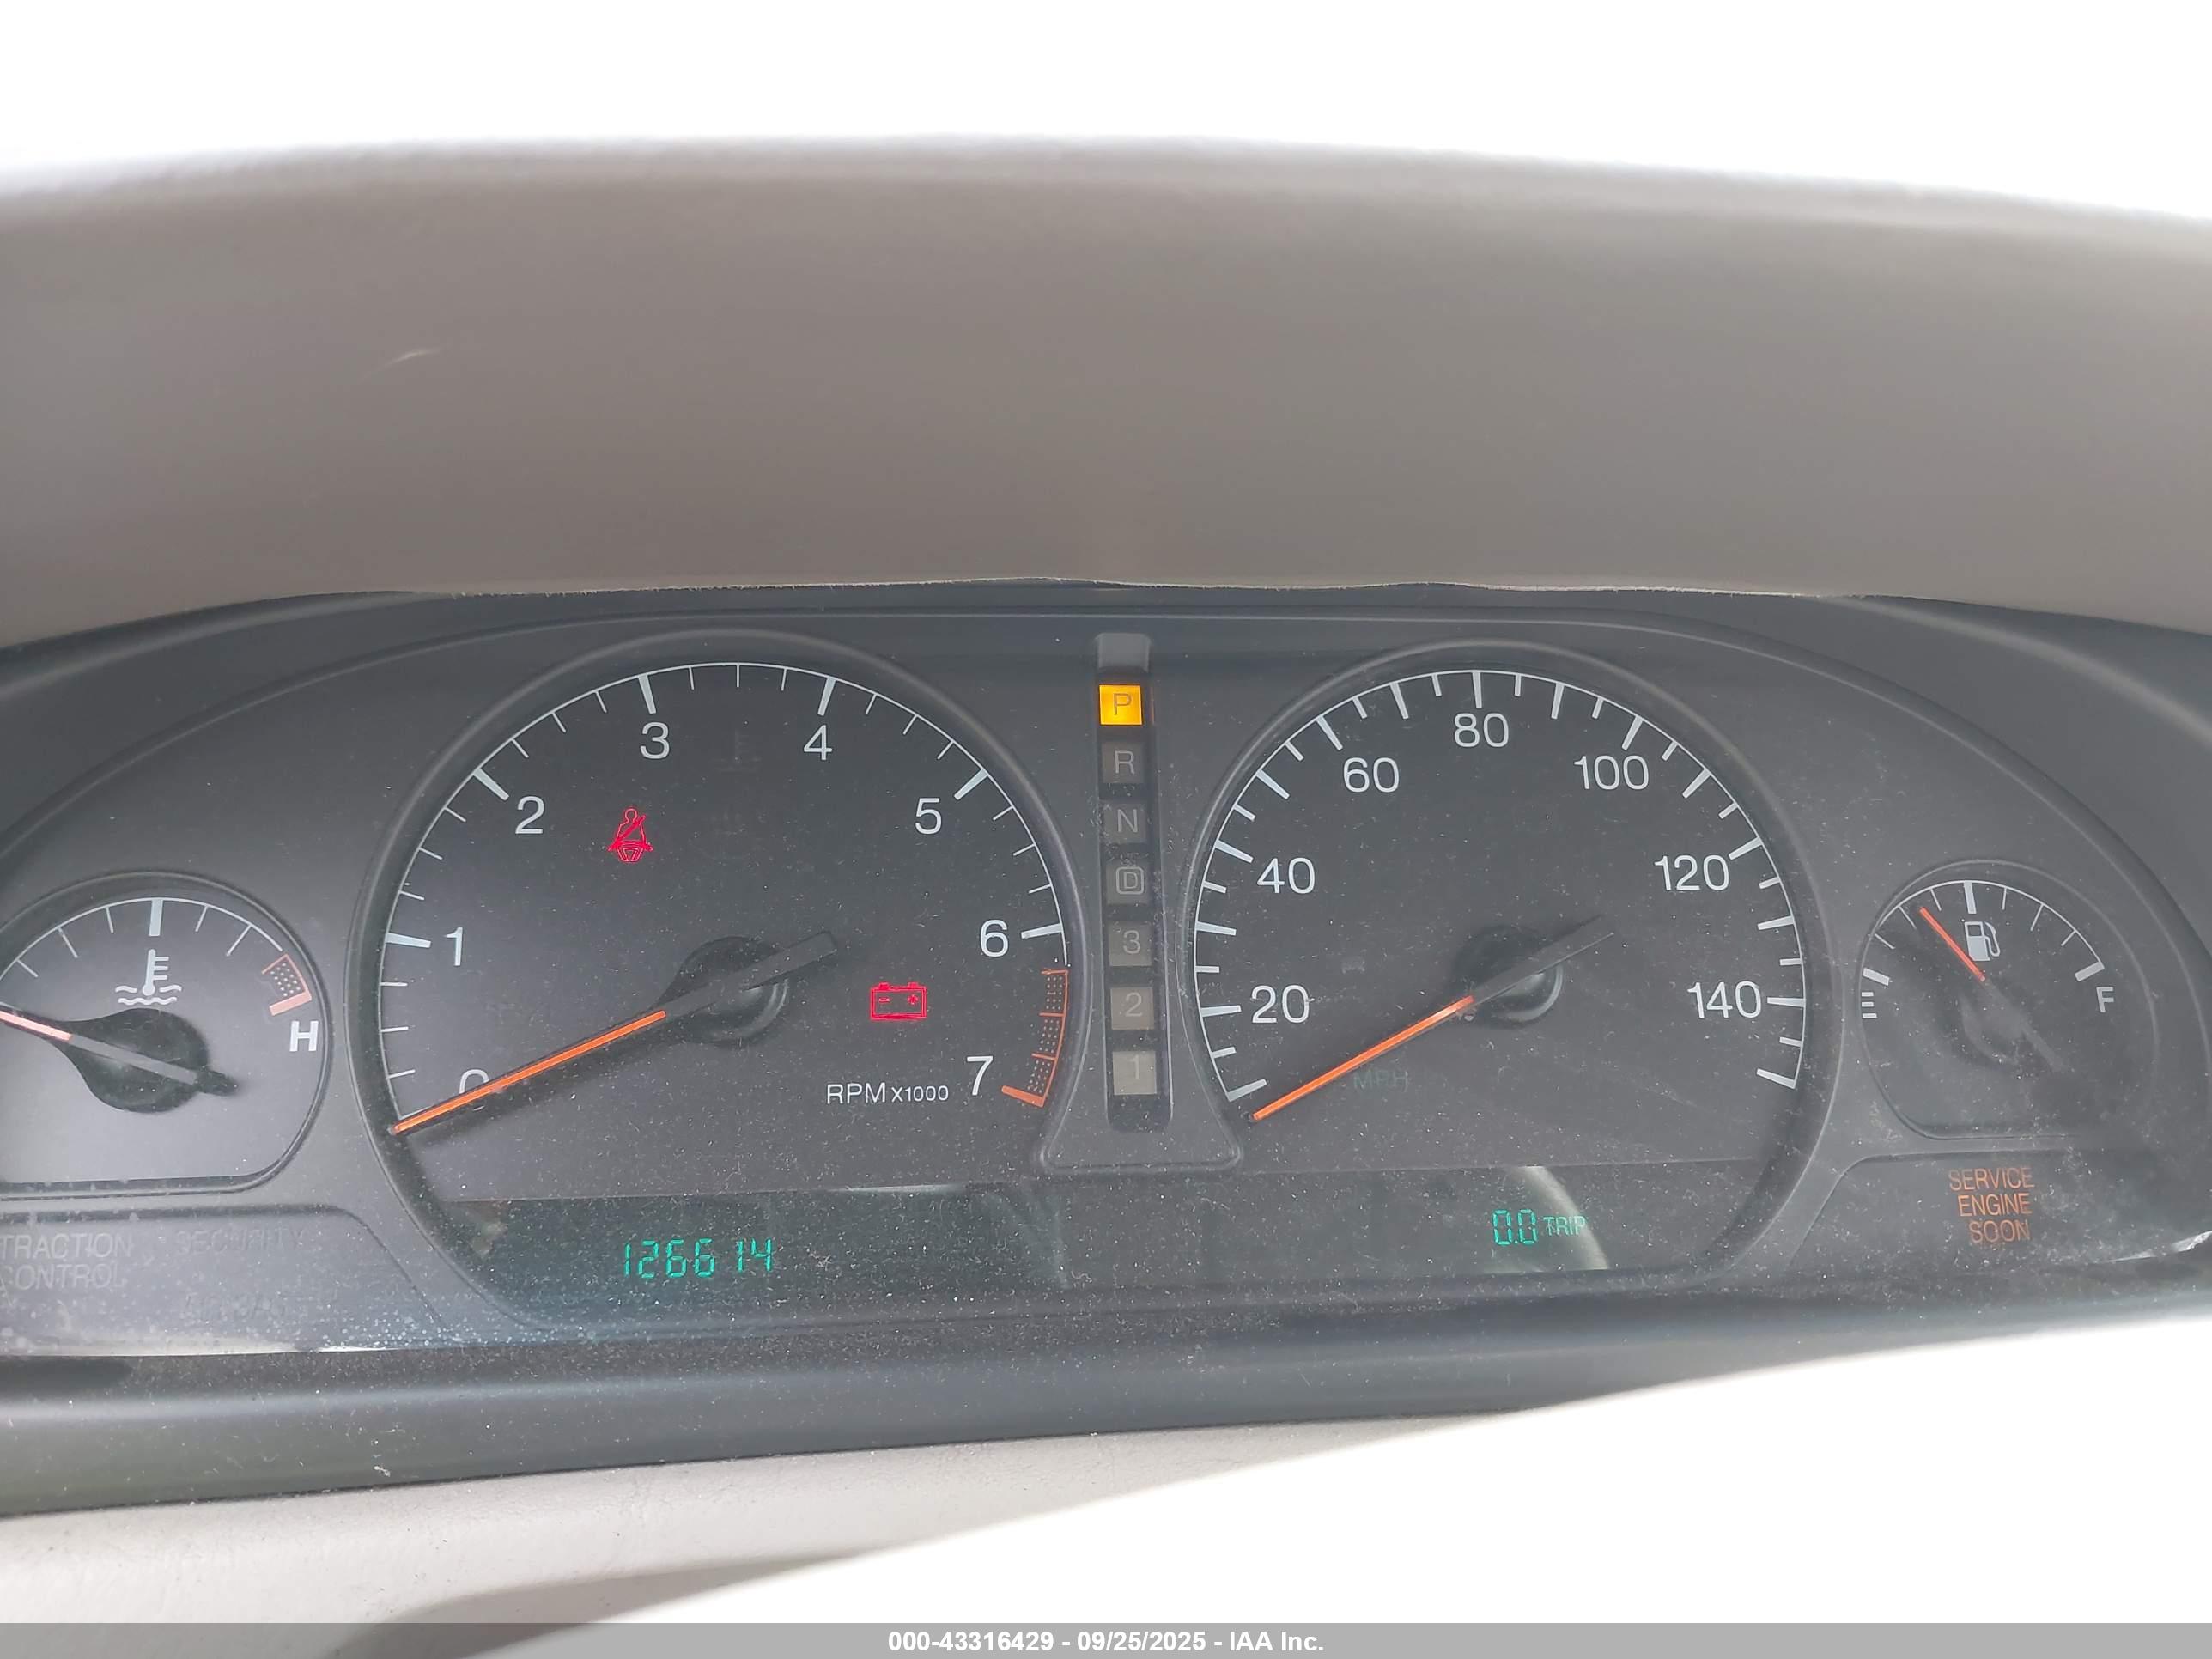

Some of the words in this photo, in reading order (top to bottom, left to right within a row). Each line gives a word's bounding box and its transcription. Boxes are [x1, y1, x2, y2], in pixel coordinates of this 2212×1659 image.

[1113, 693, 1133, 716] P
[640, 721, 670, 759] 3
[803, 724, 833, 761] 4
[1453, 712, 1510, 749] 80
[1114, 750, 1135, 775] R
[1342, 756, 1401, 794] 60
[1573, 755, 1650, 791] 100
[514, 795, 544, 835] 2
[915, 797, 943, 835] 5
[1117, 808, 1139, 833] N
[1256, 855, 1316, 895] 40
[1654, 854, 1730, 892] 120
[444, 927, 464, 967] 1
[979, 919, 1009, 957] 6
[1122, 929, 1141, 955] 3
[1124, 992, 1143, 1018] 2
[1250, 983, 1310, 1024] 20
[1686, 981, 1763, 1020] 140
[2095, 986, 2116, 1013] F
[289, 1020, 319, 1052] H
[966, 1055, 994, 1096] 7
[1130, 1054, 1141, 1081] 1
[826, 1081, 887, 1106] RPM
[1948, 1166, 2036, 1192] SERVICE
[1957, 1192, 2033, 1218] ENGINE
[1492, 1208, 1539, 1246] 0.0
[1543, 1215, 1587, 1237] TRIP
[1968, 1219, 2033, 1243] SOON
